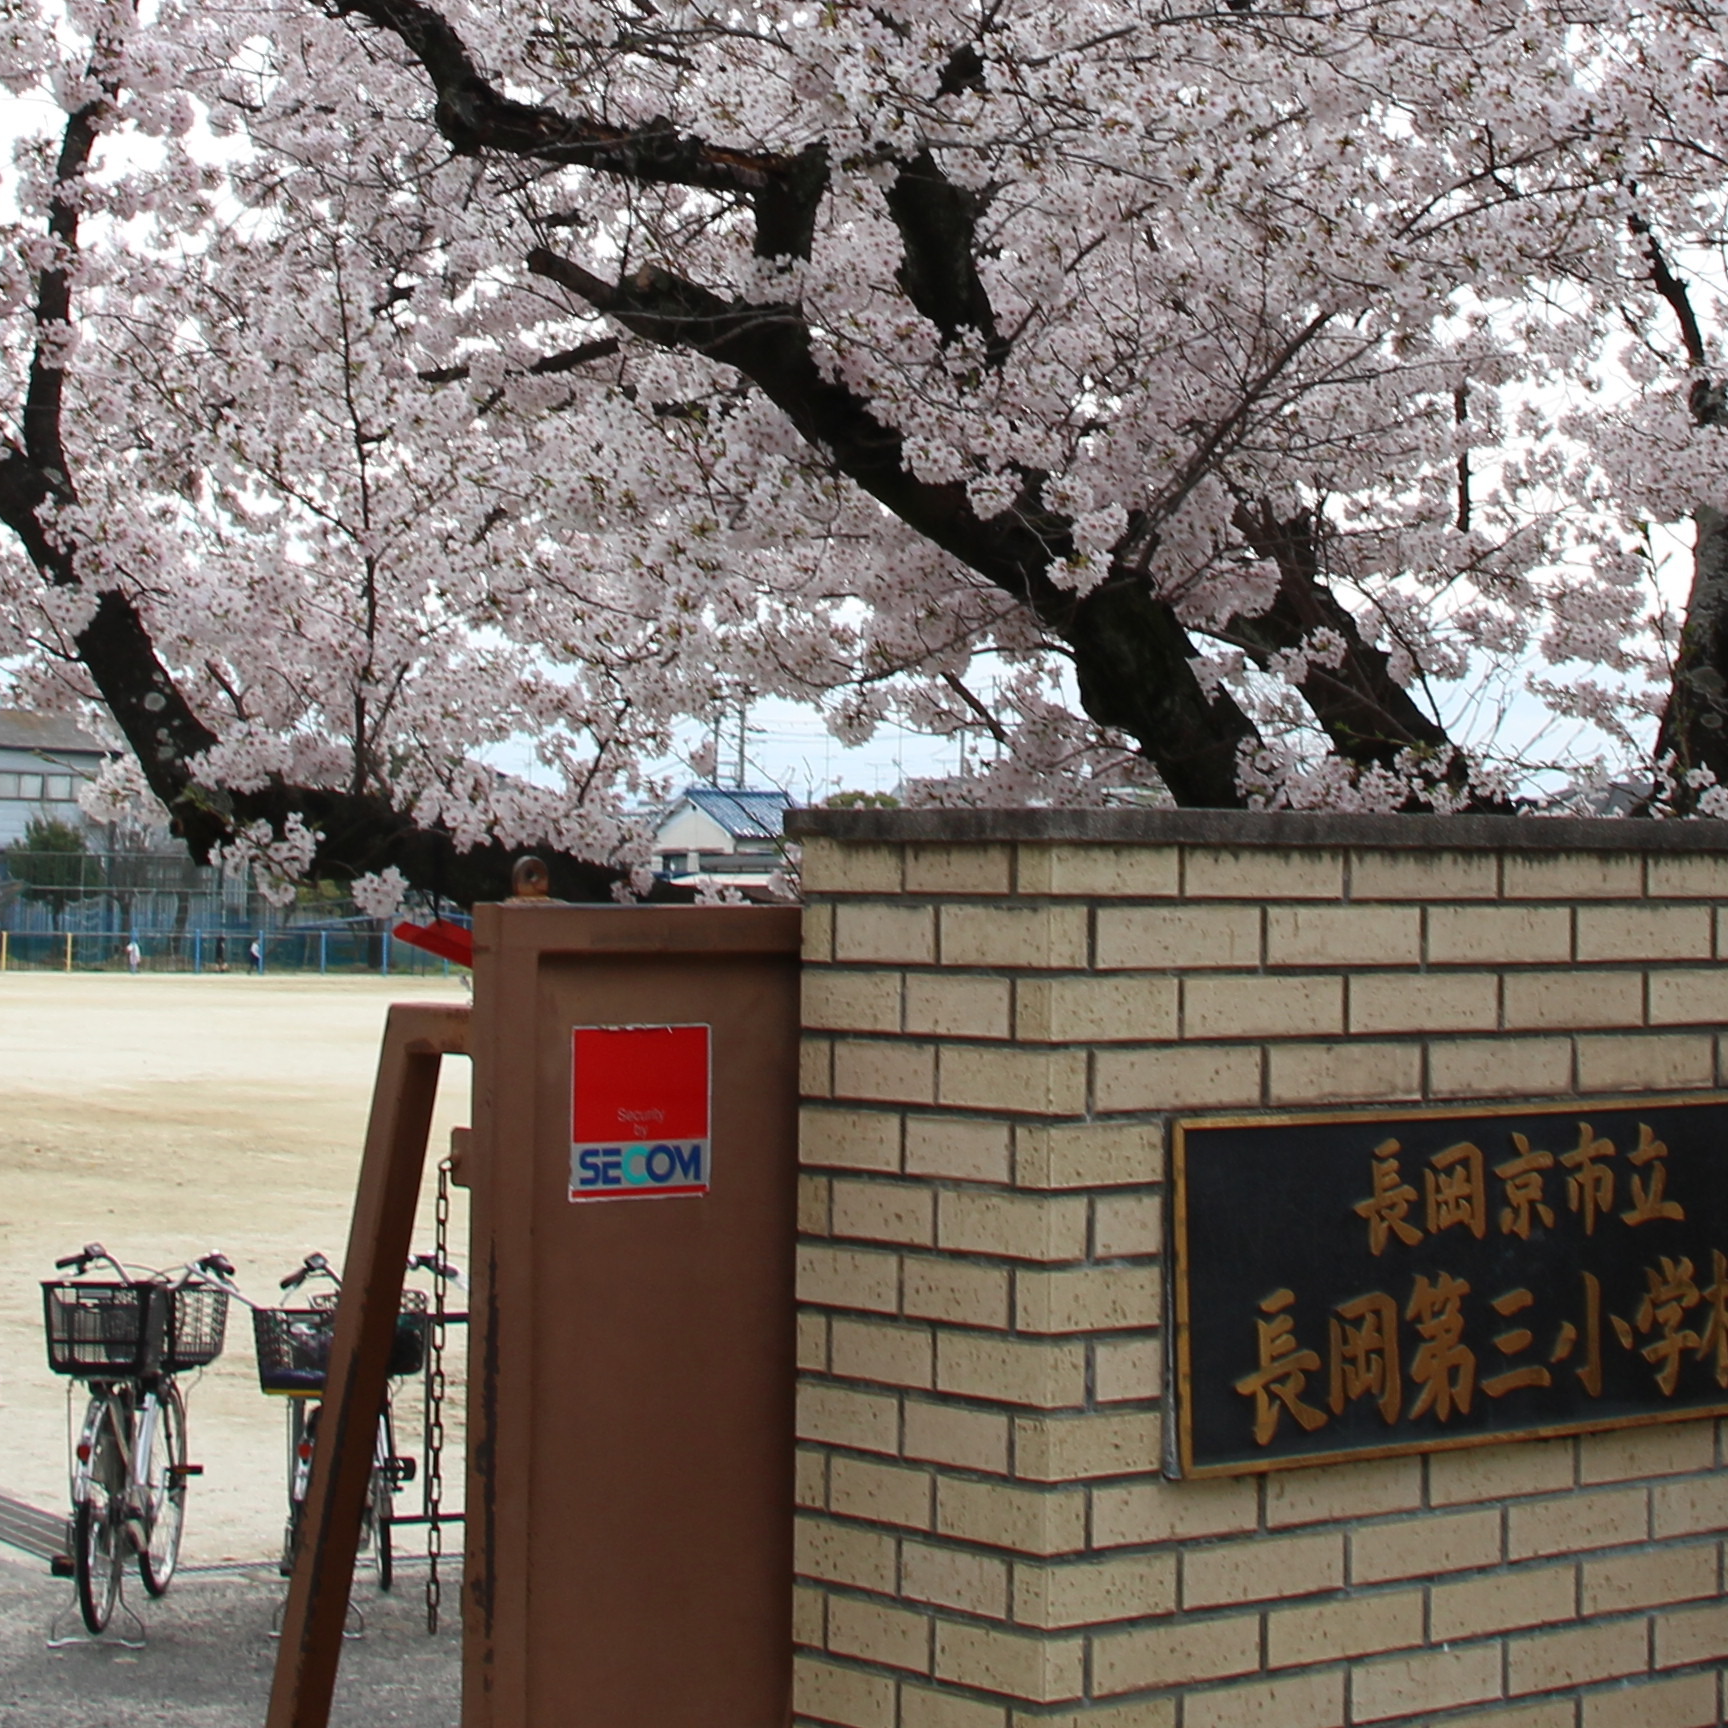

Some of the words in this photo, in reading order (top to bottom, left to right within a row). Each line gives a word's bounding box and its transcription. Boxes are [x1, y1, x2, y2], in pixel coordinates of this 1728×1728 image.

[617, 1107, 664, 1124] Security
[633, 1123, 648, 1139] by
[579, 1143, 701, 1186] SECOM
[1355, 1122, 1684, 1256] 長岡京市立
